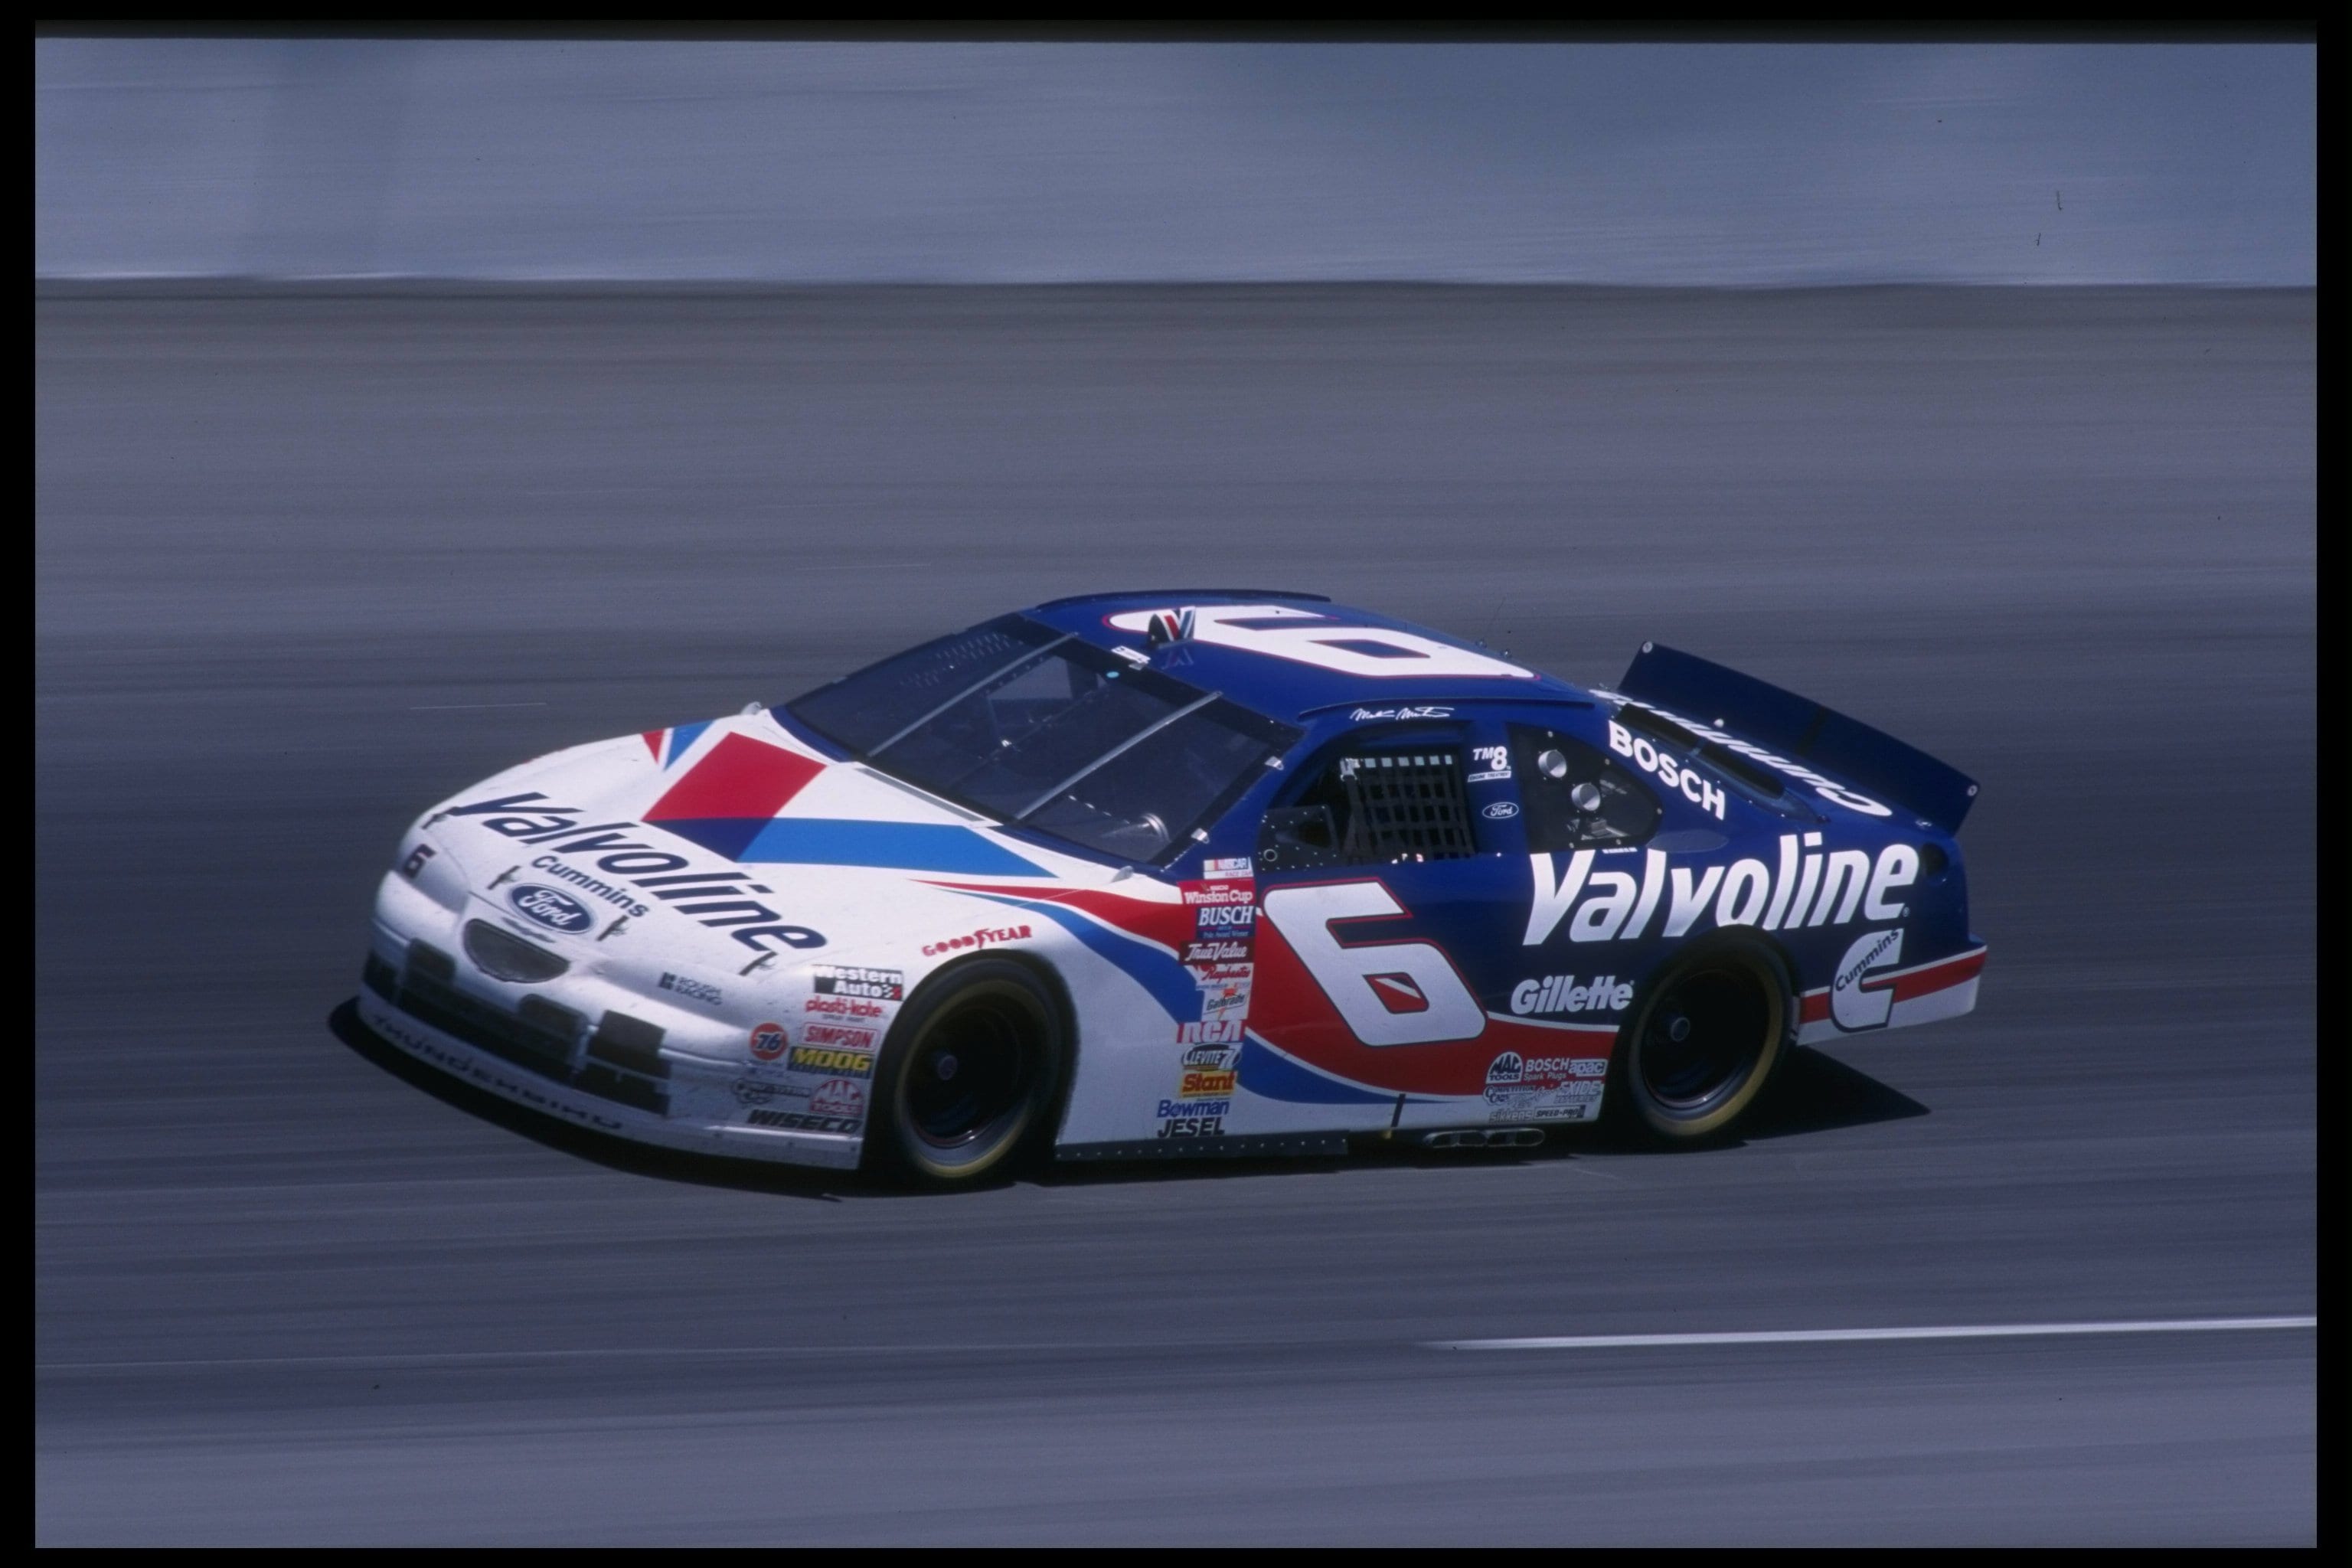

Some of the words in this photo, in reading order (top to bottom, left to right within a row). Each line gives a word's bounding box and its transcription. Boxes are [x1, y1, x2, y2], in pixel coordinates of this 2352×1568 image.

[1608, 719, 1726, 821] BOSCH
[1490, 804, 1513, 817] Ford
[401, 843, 436, 879] 6
[443, 792, 827, 952] Valvoline
[532, 854, 650, 918] Cummins
[1184, 891, 1230, 904] Winston
[1229, 889, 1253, 904] Cup
[1522, 831, 1920, 946] Valvoline
[518, 889, 583, 926] Ford
[1198, 906, 1254, 926] BUSCH
[921, 923, 1032, 956] GOODYEAR
[1184, 942, 1214, 962] True
[1207, 941, 1249, 961] Value
[1834, 929, 1900, 992] Cummins
[1262, 880, 1488, 1047] 6
[813, 965, 902, 985] Western
[833, 980, 884, 998] Auto
[1510, 974, 1633, 1014] Gillette
[805, 995, 883, 1018] plasti-kote
[756, 1031, 782, 1052] 76
[805, 1025, 875, 1049] SIMPSON
[1181, 1019, 1243, 1043] RCA
[792, 1047, 874, 1072] MOOG
[1183, 1046, 1222, 1067] CLEVITE
[1524, 1057, 1570, 1072] BOSCH
[1182, 1071, 1238, 1093] Stant
[1488, 1073, 1520, 1081] TOOLS
[1524, 1073, 1544, 1081] Spark
[1547, 1071, 1567, 1080] Plugs
[1557, 1080, 1602, 1096] EXIDE
[1156, 1099, 1230, 1119] Bowman
[746, 1109, 866, 1134] WISECO
[1157, 1117, 1225, 1138] JESEL
